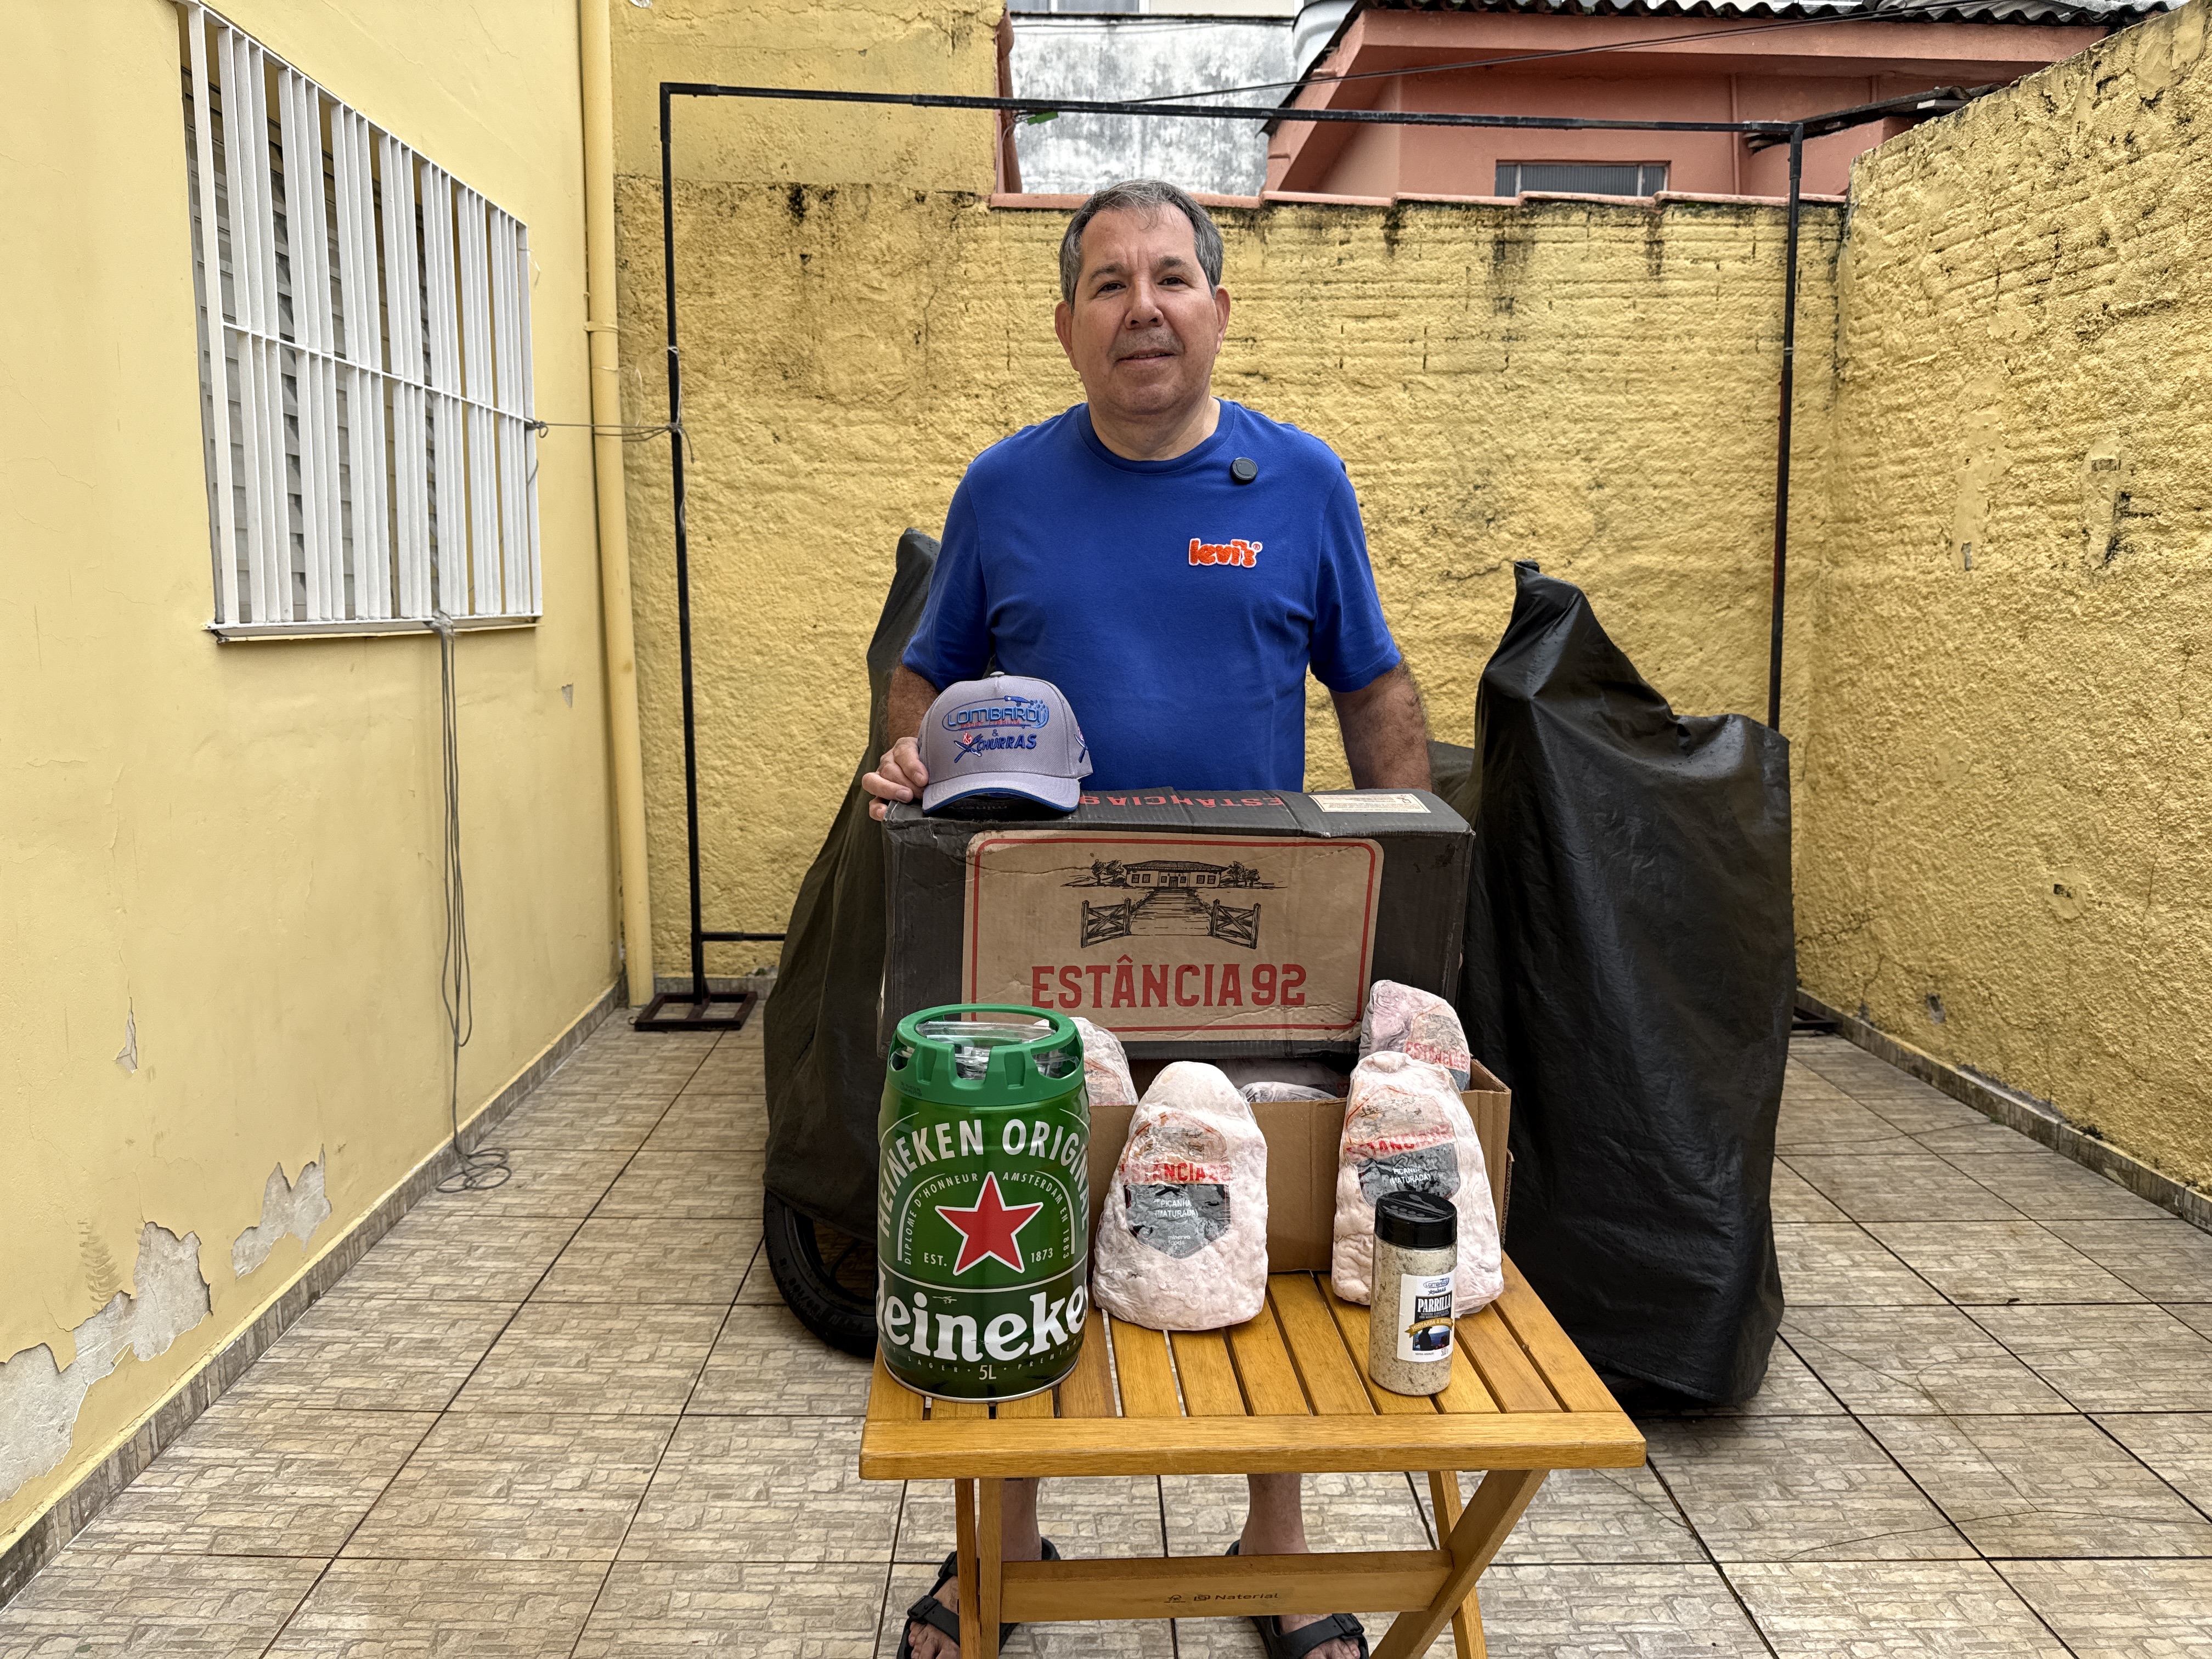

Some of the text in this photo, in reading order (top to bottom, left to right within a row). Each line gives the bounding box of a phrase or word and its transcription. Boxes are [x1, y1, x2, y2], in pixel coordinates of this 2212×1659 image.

[948, 707, 1041, 726] LOMBARDI
[977, 733, 1037, 752] CHURRAS
[1080, 795, 1285, 808] ESTÂNCIA9
[1031, 953, 1307, 1009] ESTÂNCIA92
[878, 1119, 1089, 1238] HEINEKEN ORIGINAL
[904, 1210, 917, 1265] DIPLOME
[914, 1173, 978, 1207] D'HONNEUR
[1002, 1172, 1063, 1204] AMSTERDAM
[1060, 1206, 1068, 1223] EN
[1154, 1209, 1198, 1218] (MATURADA)
[924, 1248, 1053, 1266] EST. 1873
[1417, 1294, 1451, 1313] PARRILLA
[1411, 1319, 1436, 1331] MOSTARDA
[909, 1356, 958, 1373] LAGER
[979, 1364, 997, 1380] 5L
